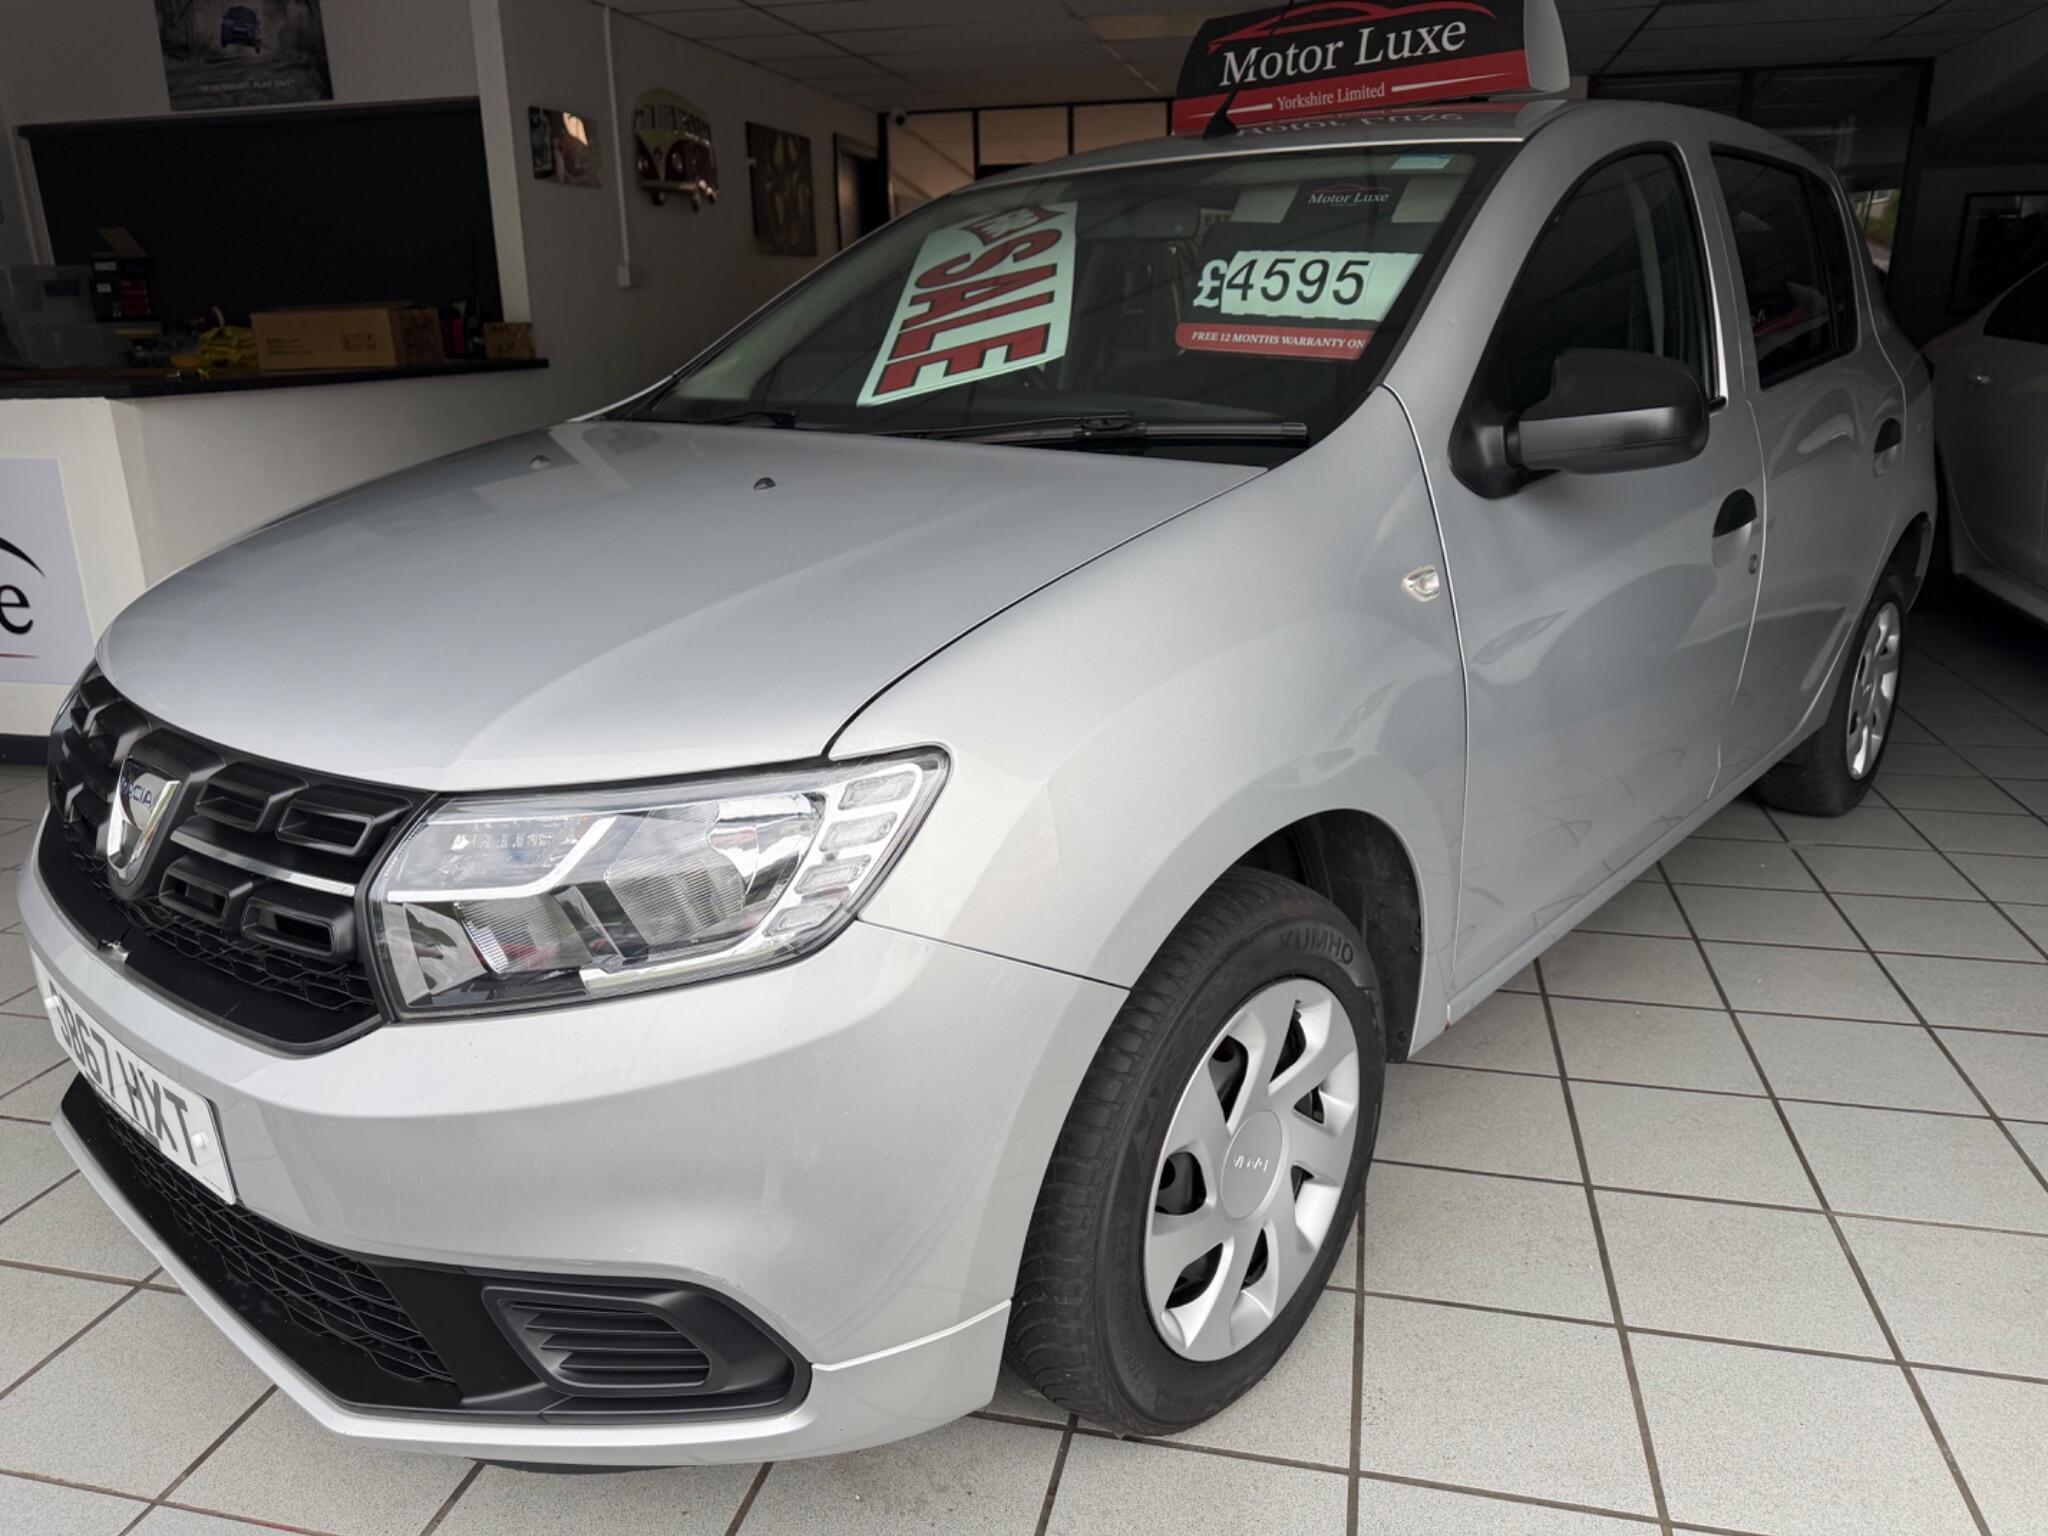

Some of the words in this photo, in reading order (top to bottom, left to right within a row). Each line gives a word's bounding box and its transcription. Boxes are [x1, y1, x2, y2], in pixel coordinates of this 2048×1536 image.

[1219, 40, 1345, 87] Motor
[1355, 19, 1467, 67] Luxe
[1276, 91, 1334, 111] Yorkshire
[1337, 82, 1385, 103] Limited
[1308, 192, 1351, 204] Motor
[1354, 191, 1389, 203] Luxe
[1193, 258, 1370, 308] £4595
[871, 228, 1062, 397] SALE
[1192, 331, 1218, 342] FREE
[1220, 332, 1230, 342] 12
[1232, 333, 1279, 345] MONTHS
[1281, 335, 1346, 348] WARRANTY
[1280, 927, 1353, 965] KUMHO
[115, 1050, 197, 1167] HXT
